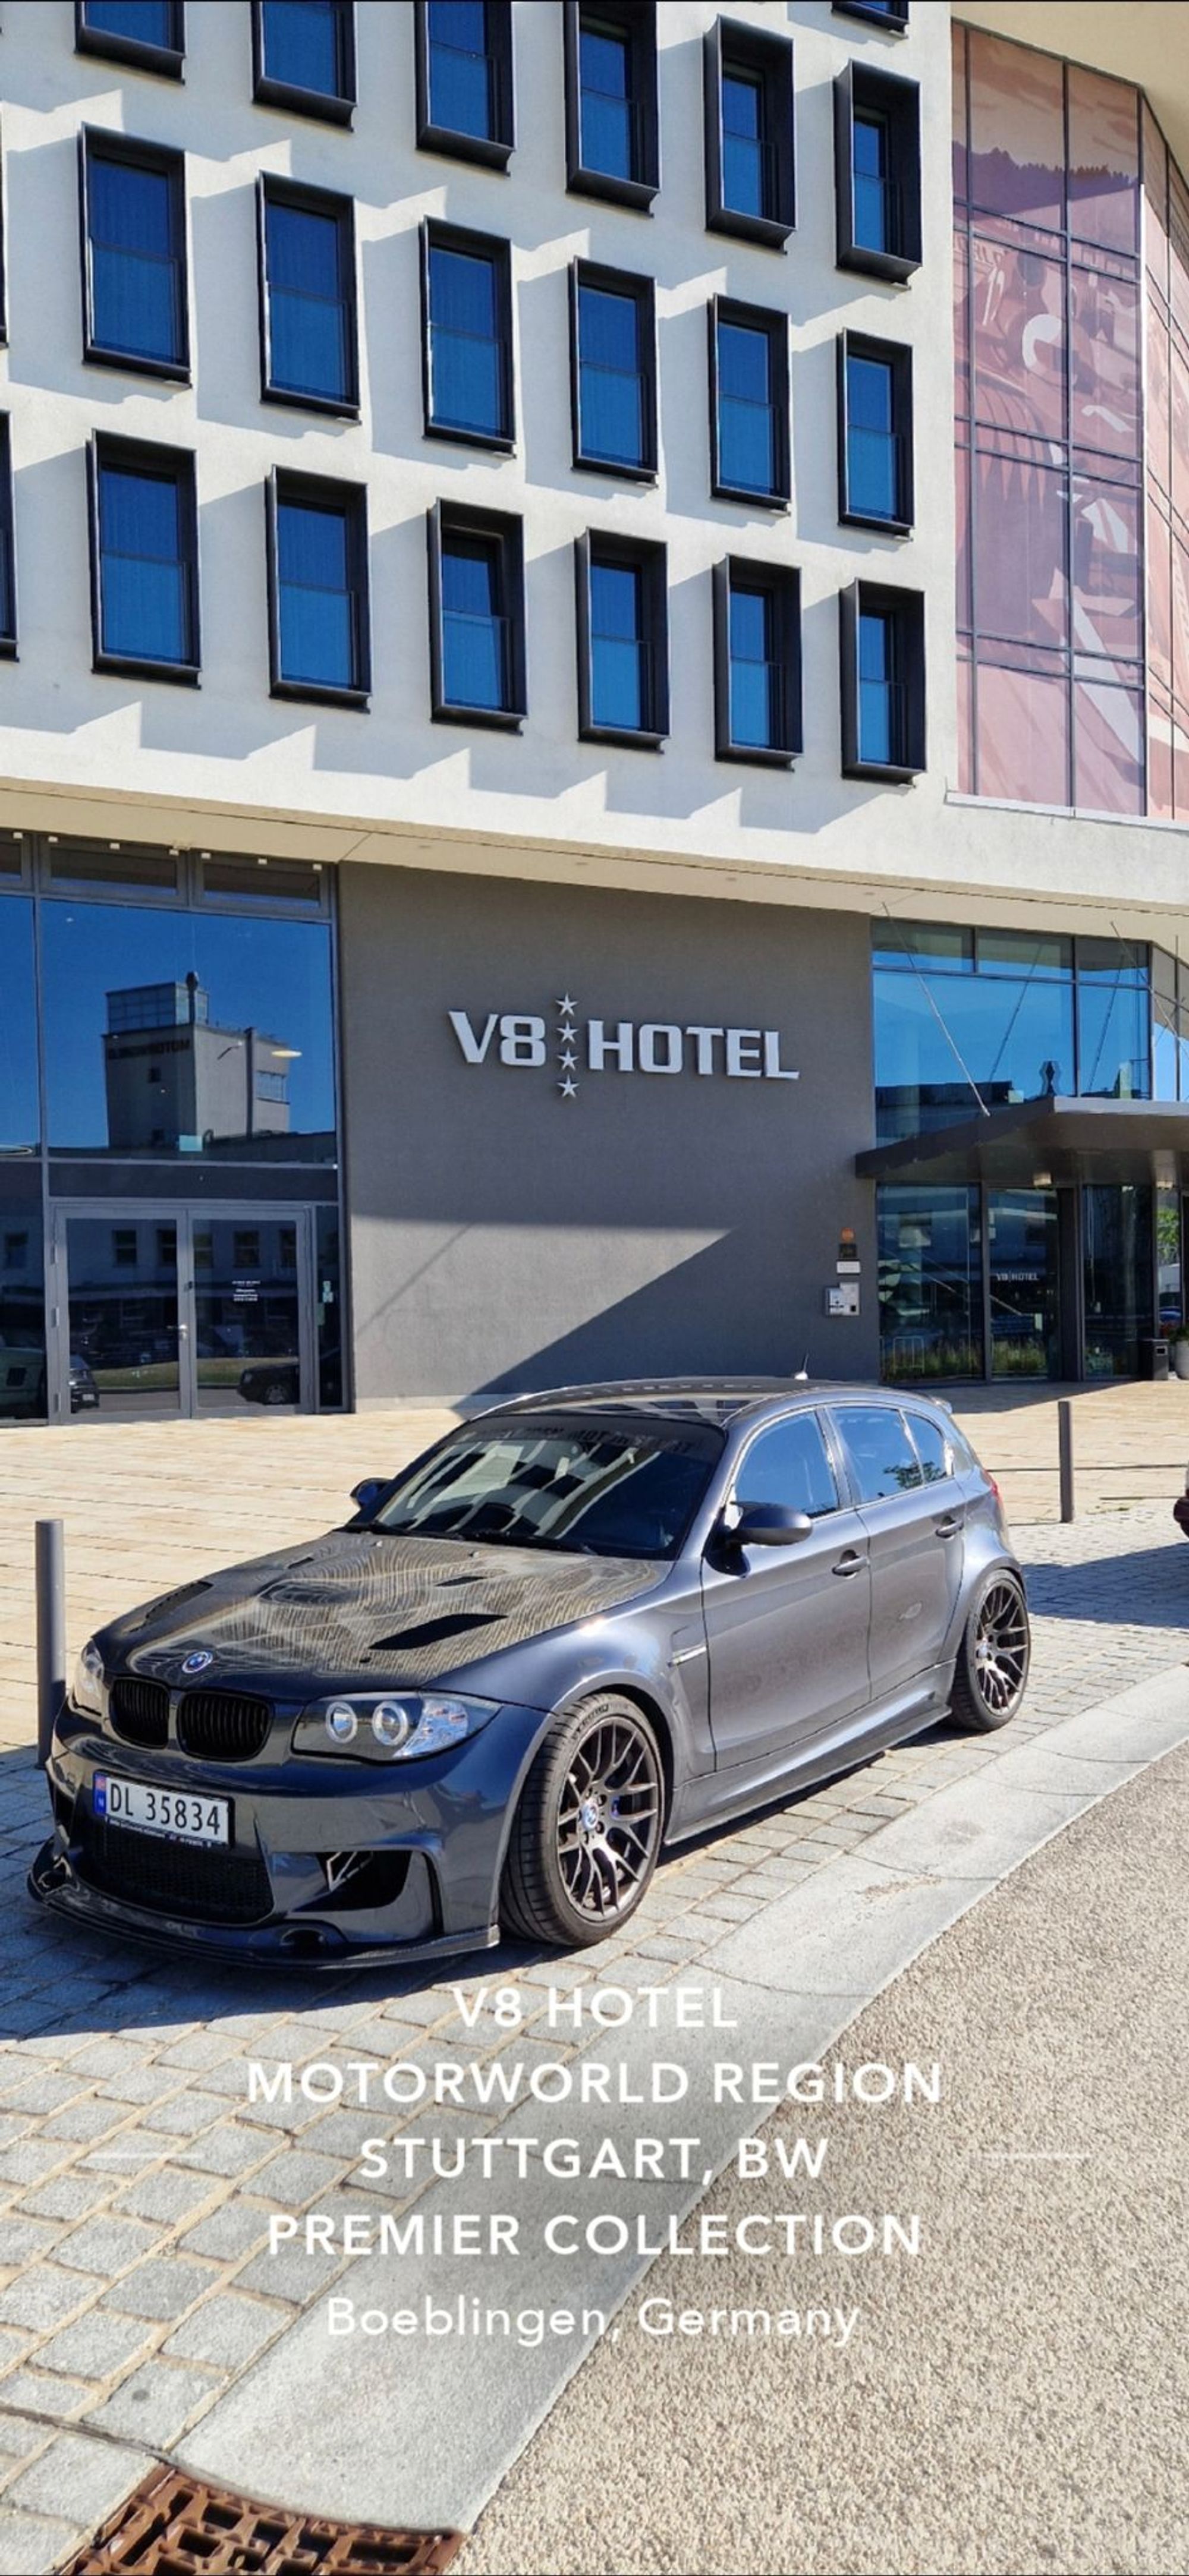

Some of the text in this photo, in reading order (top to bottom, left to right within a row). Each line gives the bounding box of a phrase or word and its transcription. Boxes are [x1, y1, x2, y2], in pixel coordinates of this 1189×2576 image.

[448, 1011, 800, 1080] V8 HOTEL
[111, 1783, 133, 1816] DL
[146, 1793, 221, 1835] 35834
